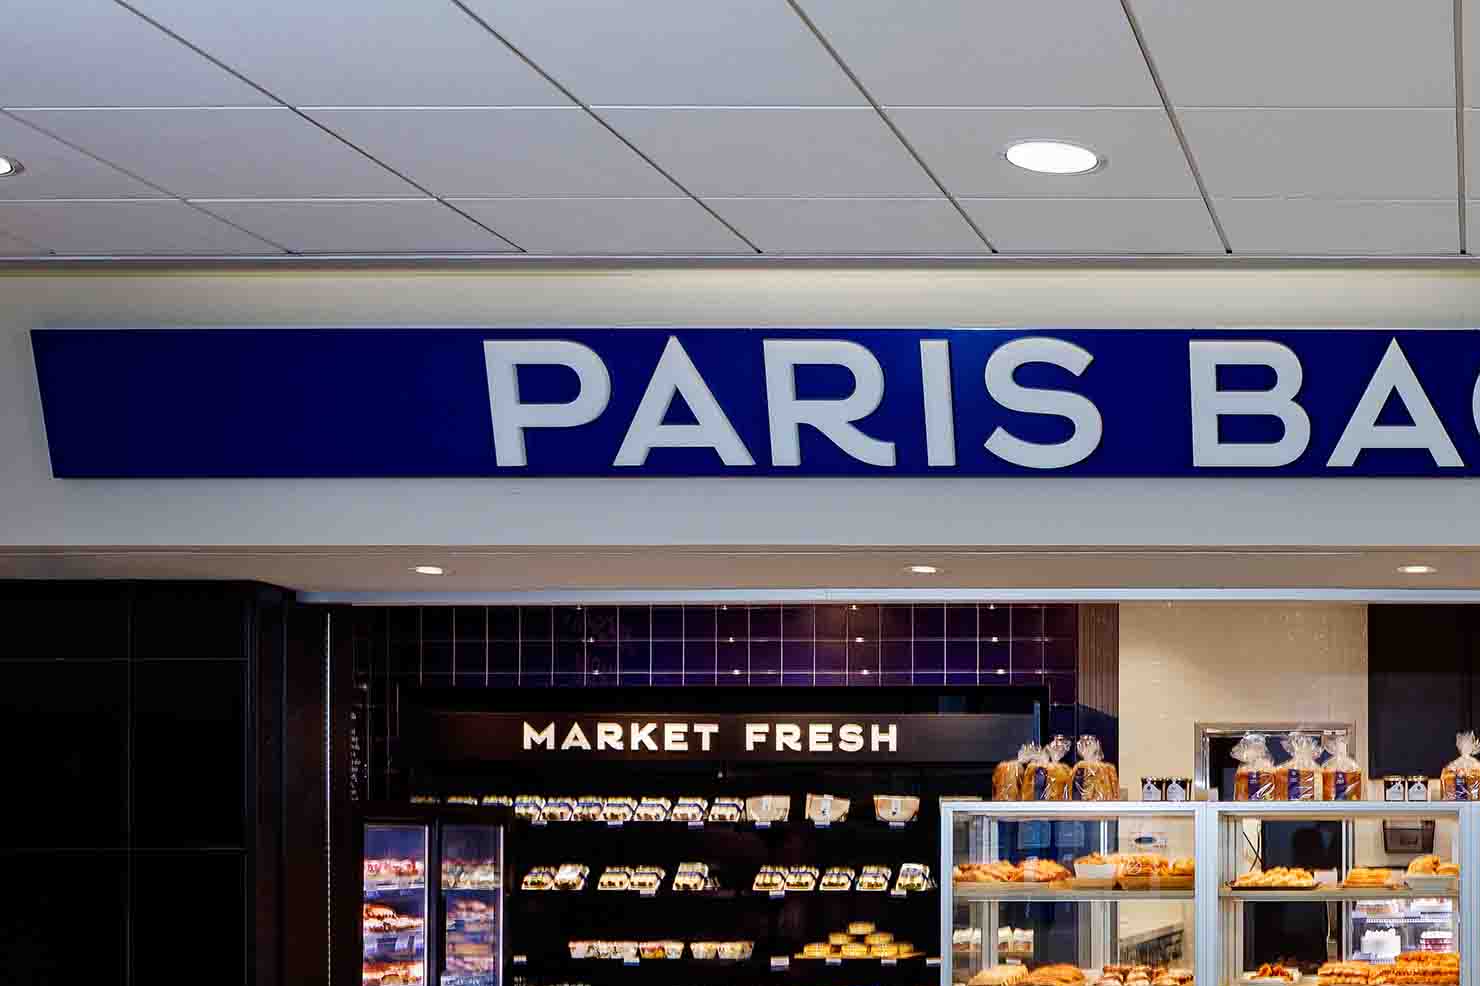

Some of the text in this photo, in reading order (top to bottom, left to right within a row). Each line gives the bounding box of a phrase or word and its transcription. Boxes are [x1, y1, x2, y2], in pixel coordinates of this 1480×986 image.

[482, 335, 1104, 469] PARIS
[523, 721, 898, 752] MARKET FRESH
